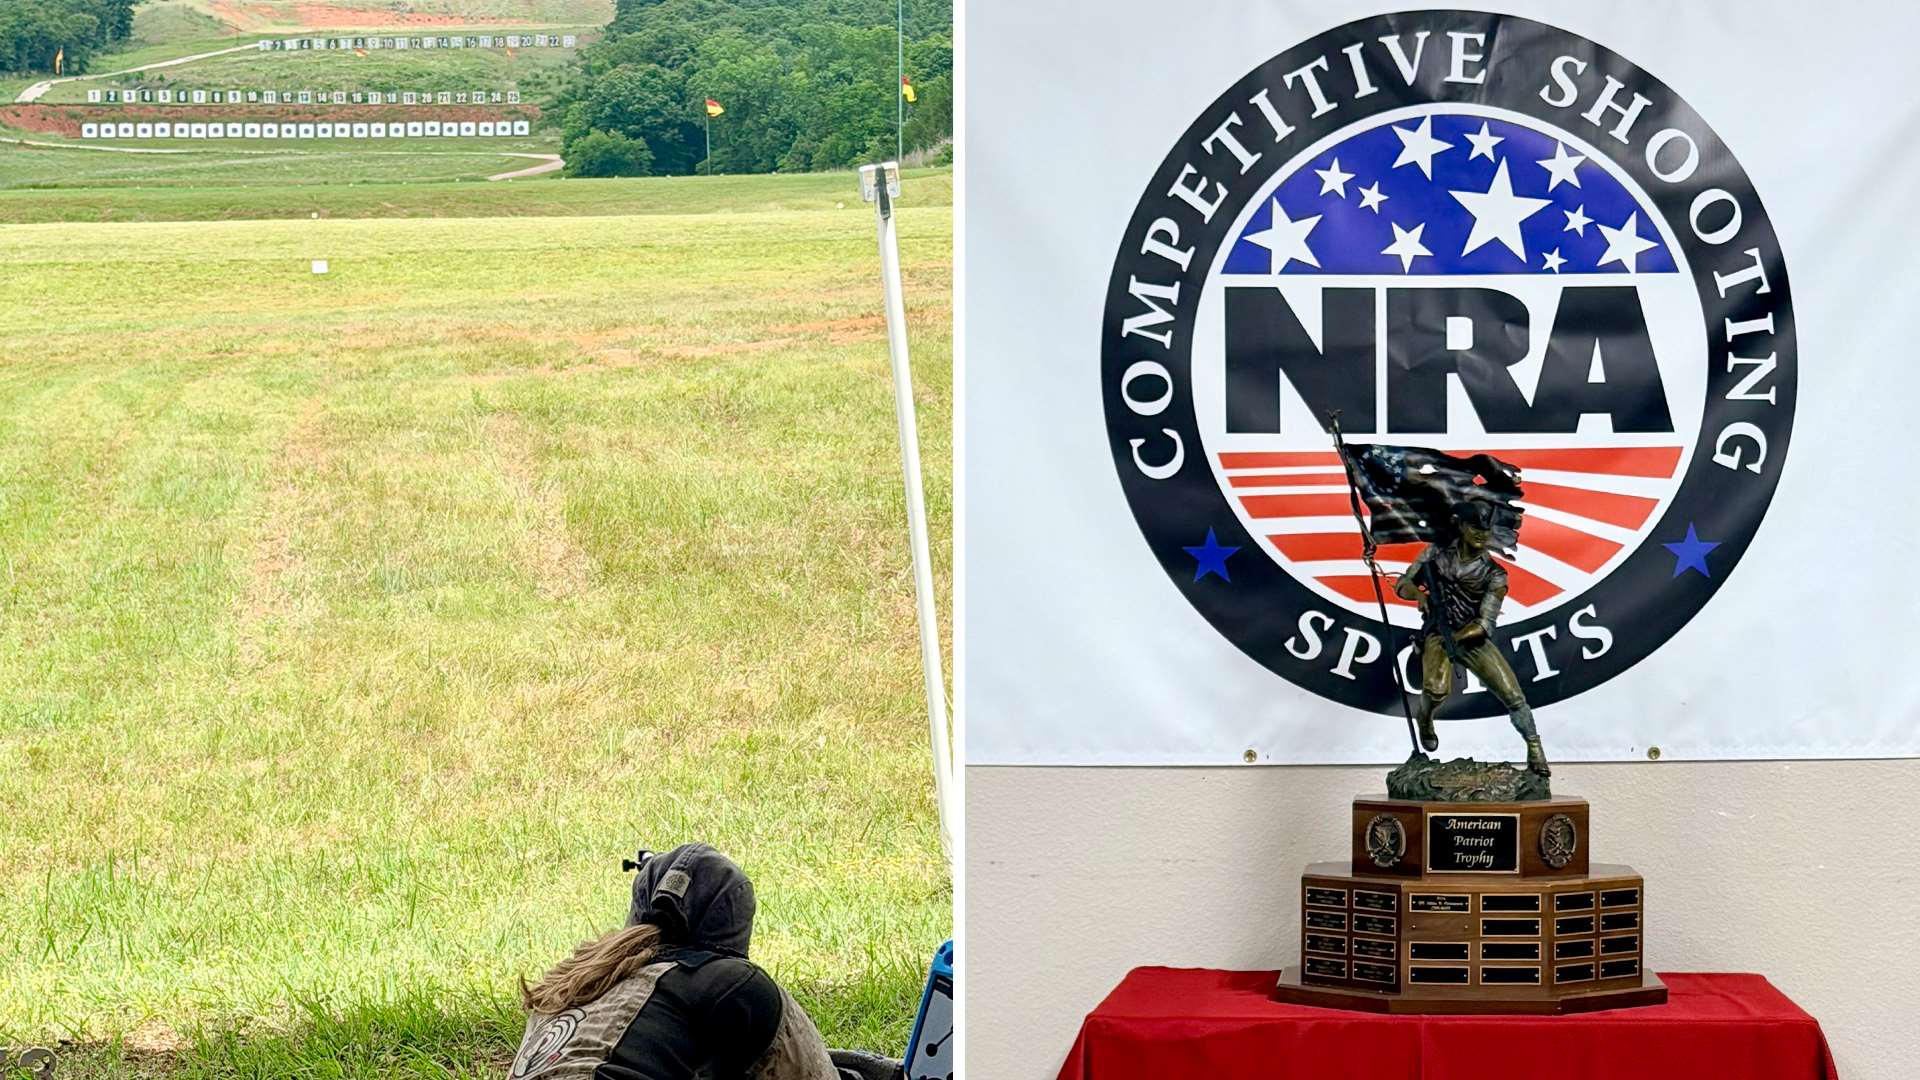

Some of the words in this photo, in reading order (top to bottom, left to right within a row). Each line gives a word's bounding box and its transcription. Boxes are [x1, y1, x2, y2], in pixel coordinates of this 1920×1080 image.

[109, 91, 116, 102] 2
[265, 92, 274, 102] 11
[1121, 31, 1488, 479] COMPETITIVE
[1538, 54, 1777, 475] SHOOTING
[1224, 286, 1674, 434] NRA
[1284, 603, 1614, 695] SPTS
[1445, 818, 1501, 830] American
[1454, 835, 1494, 847] Patriot
[1454, 850, 1494, 868] Trophy
